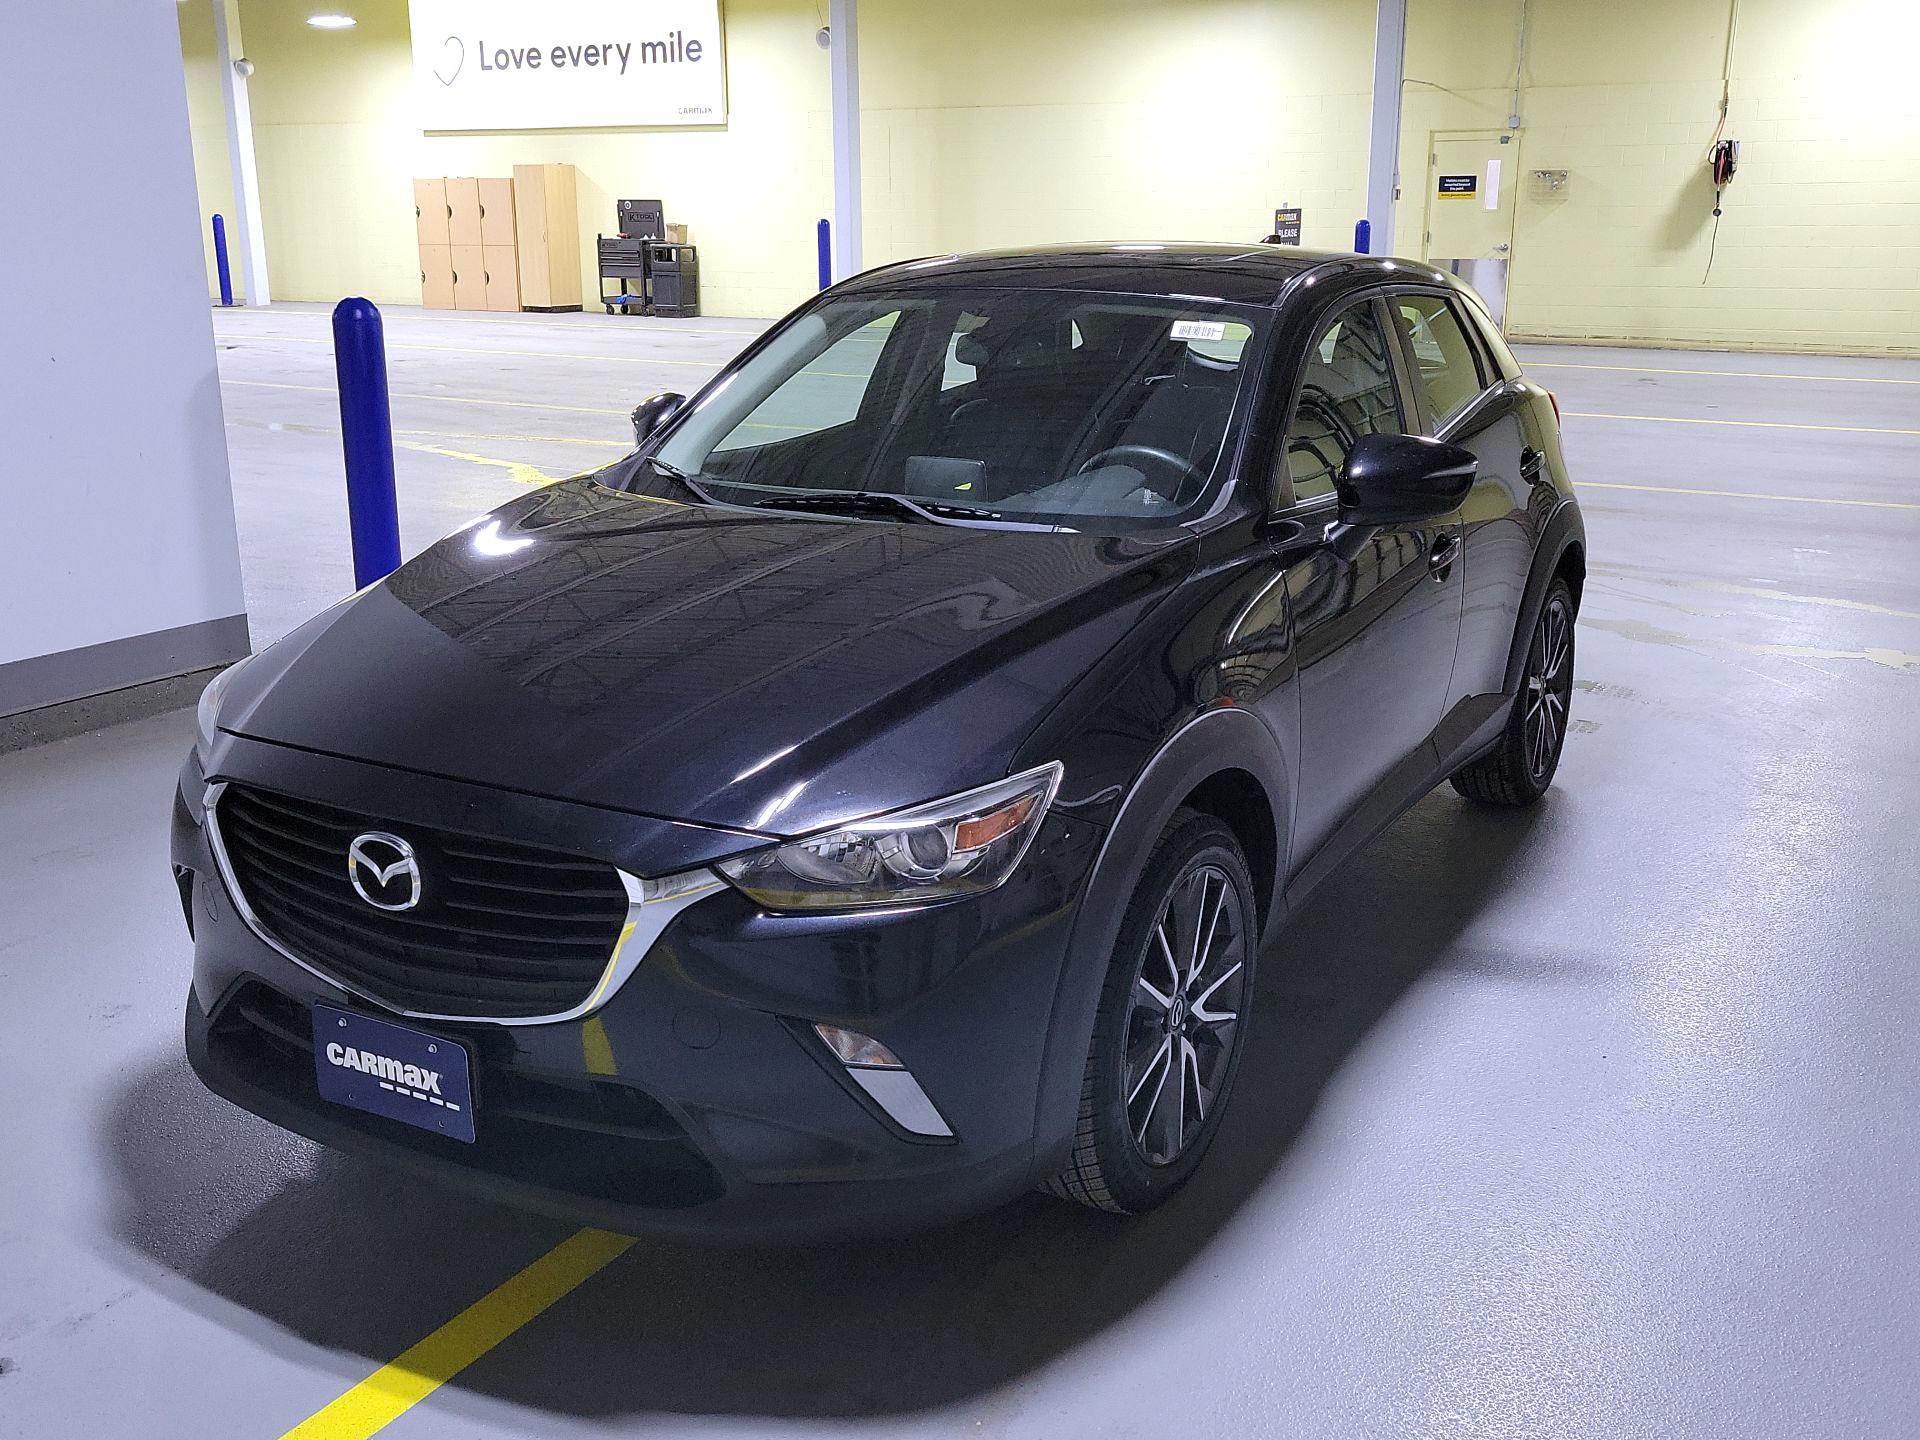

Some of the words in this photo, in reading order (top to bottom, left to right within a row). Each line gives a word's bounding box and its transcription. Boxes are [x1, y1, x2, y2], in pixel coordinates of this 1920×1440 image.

[479, 40, 542, 71] Love
[550, 42, 632, 75] every
[641, 30, 703, 64] mile
